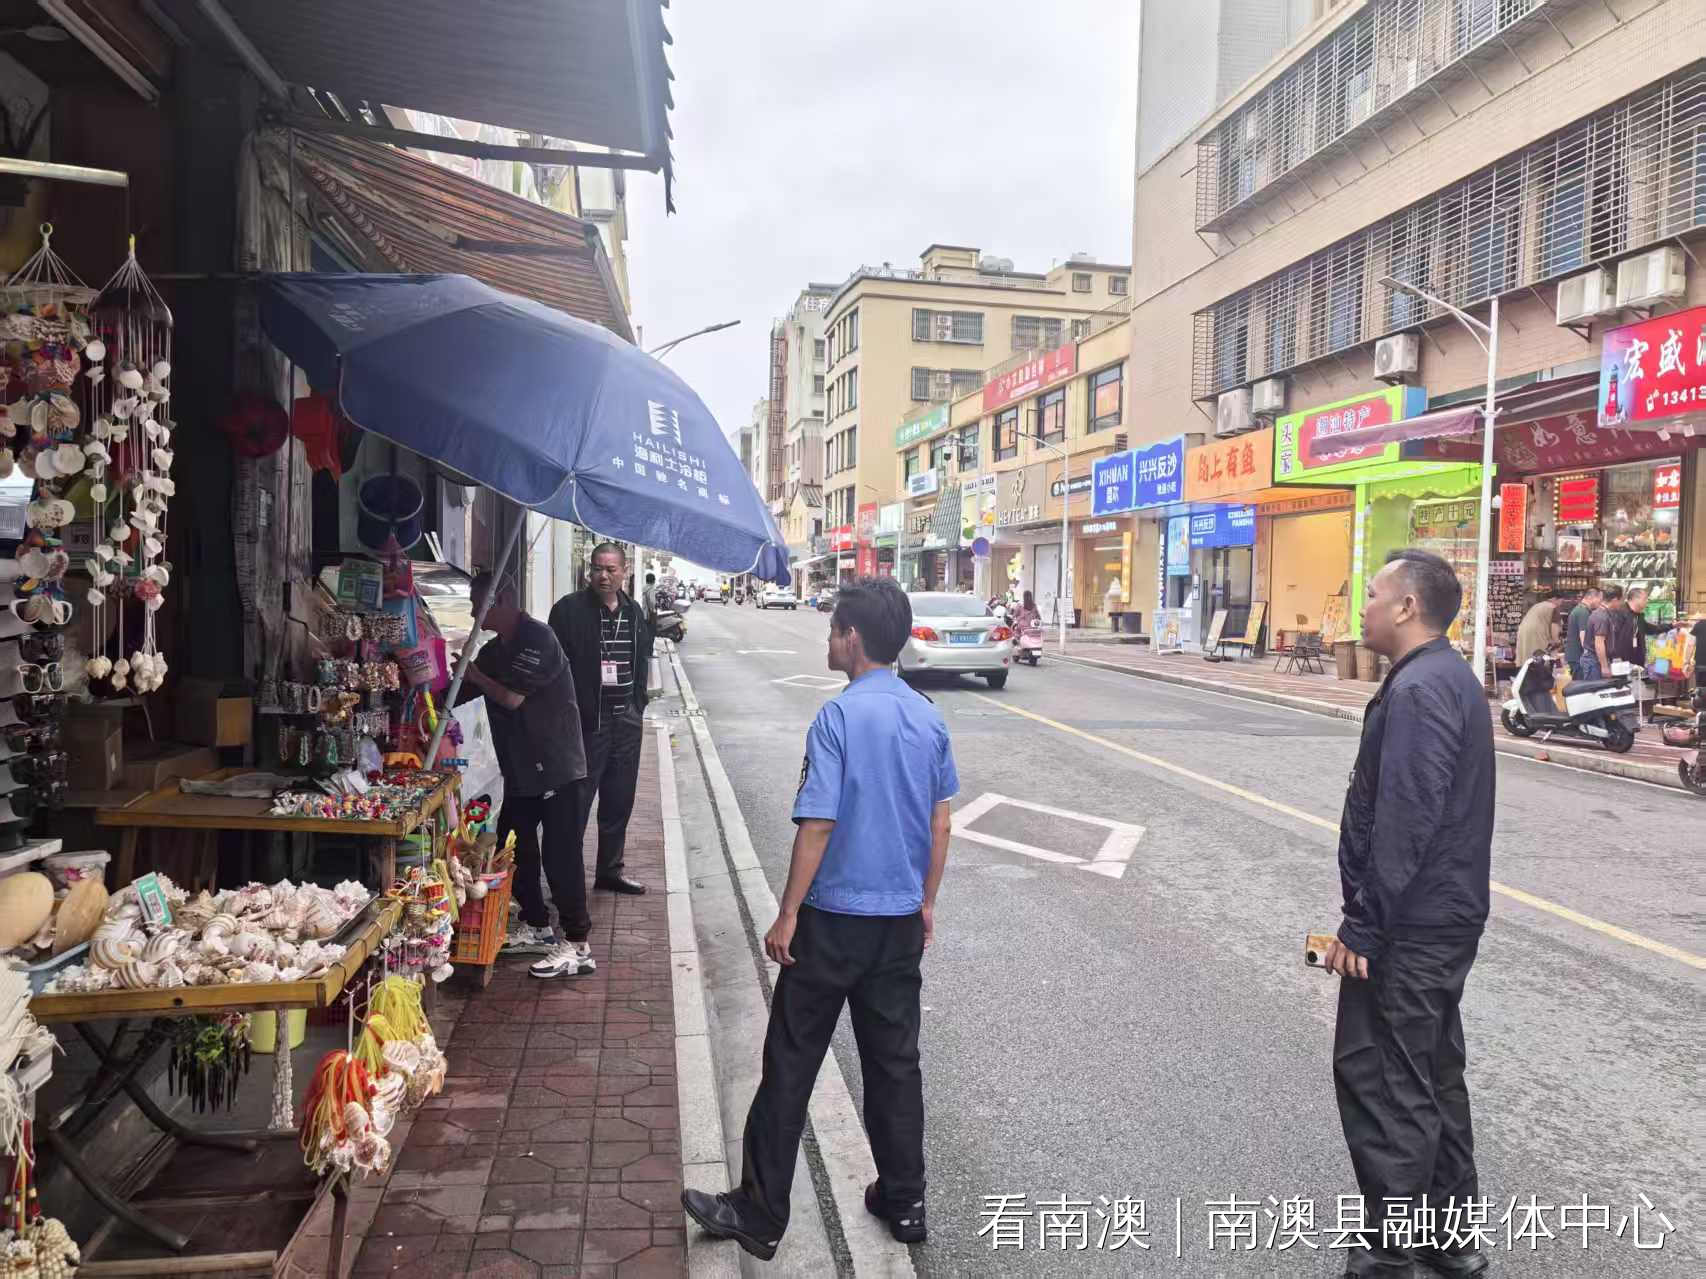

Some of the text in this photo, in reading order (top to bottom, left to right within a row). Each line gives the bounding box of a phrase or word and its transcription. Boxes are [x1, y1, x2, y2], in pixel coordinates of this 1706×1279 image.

[1623, 328, 1706, 384] 宏盛
[633, 432, 706, 469] HAILISHI
[1139, 452, 1177, 482] 兴兴反沙
[1099, 464, 1128, 487] XIHUAN
